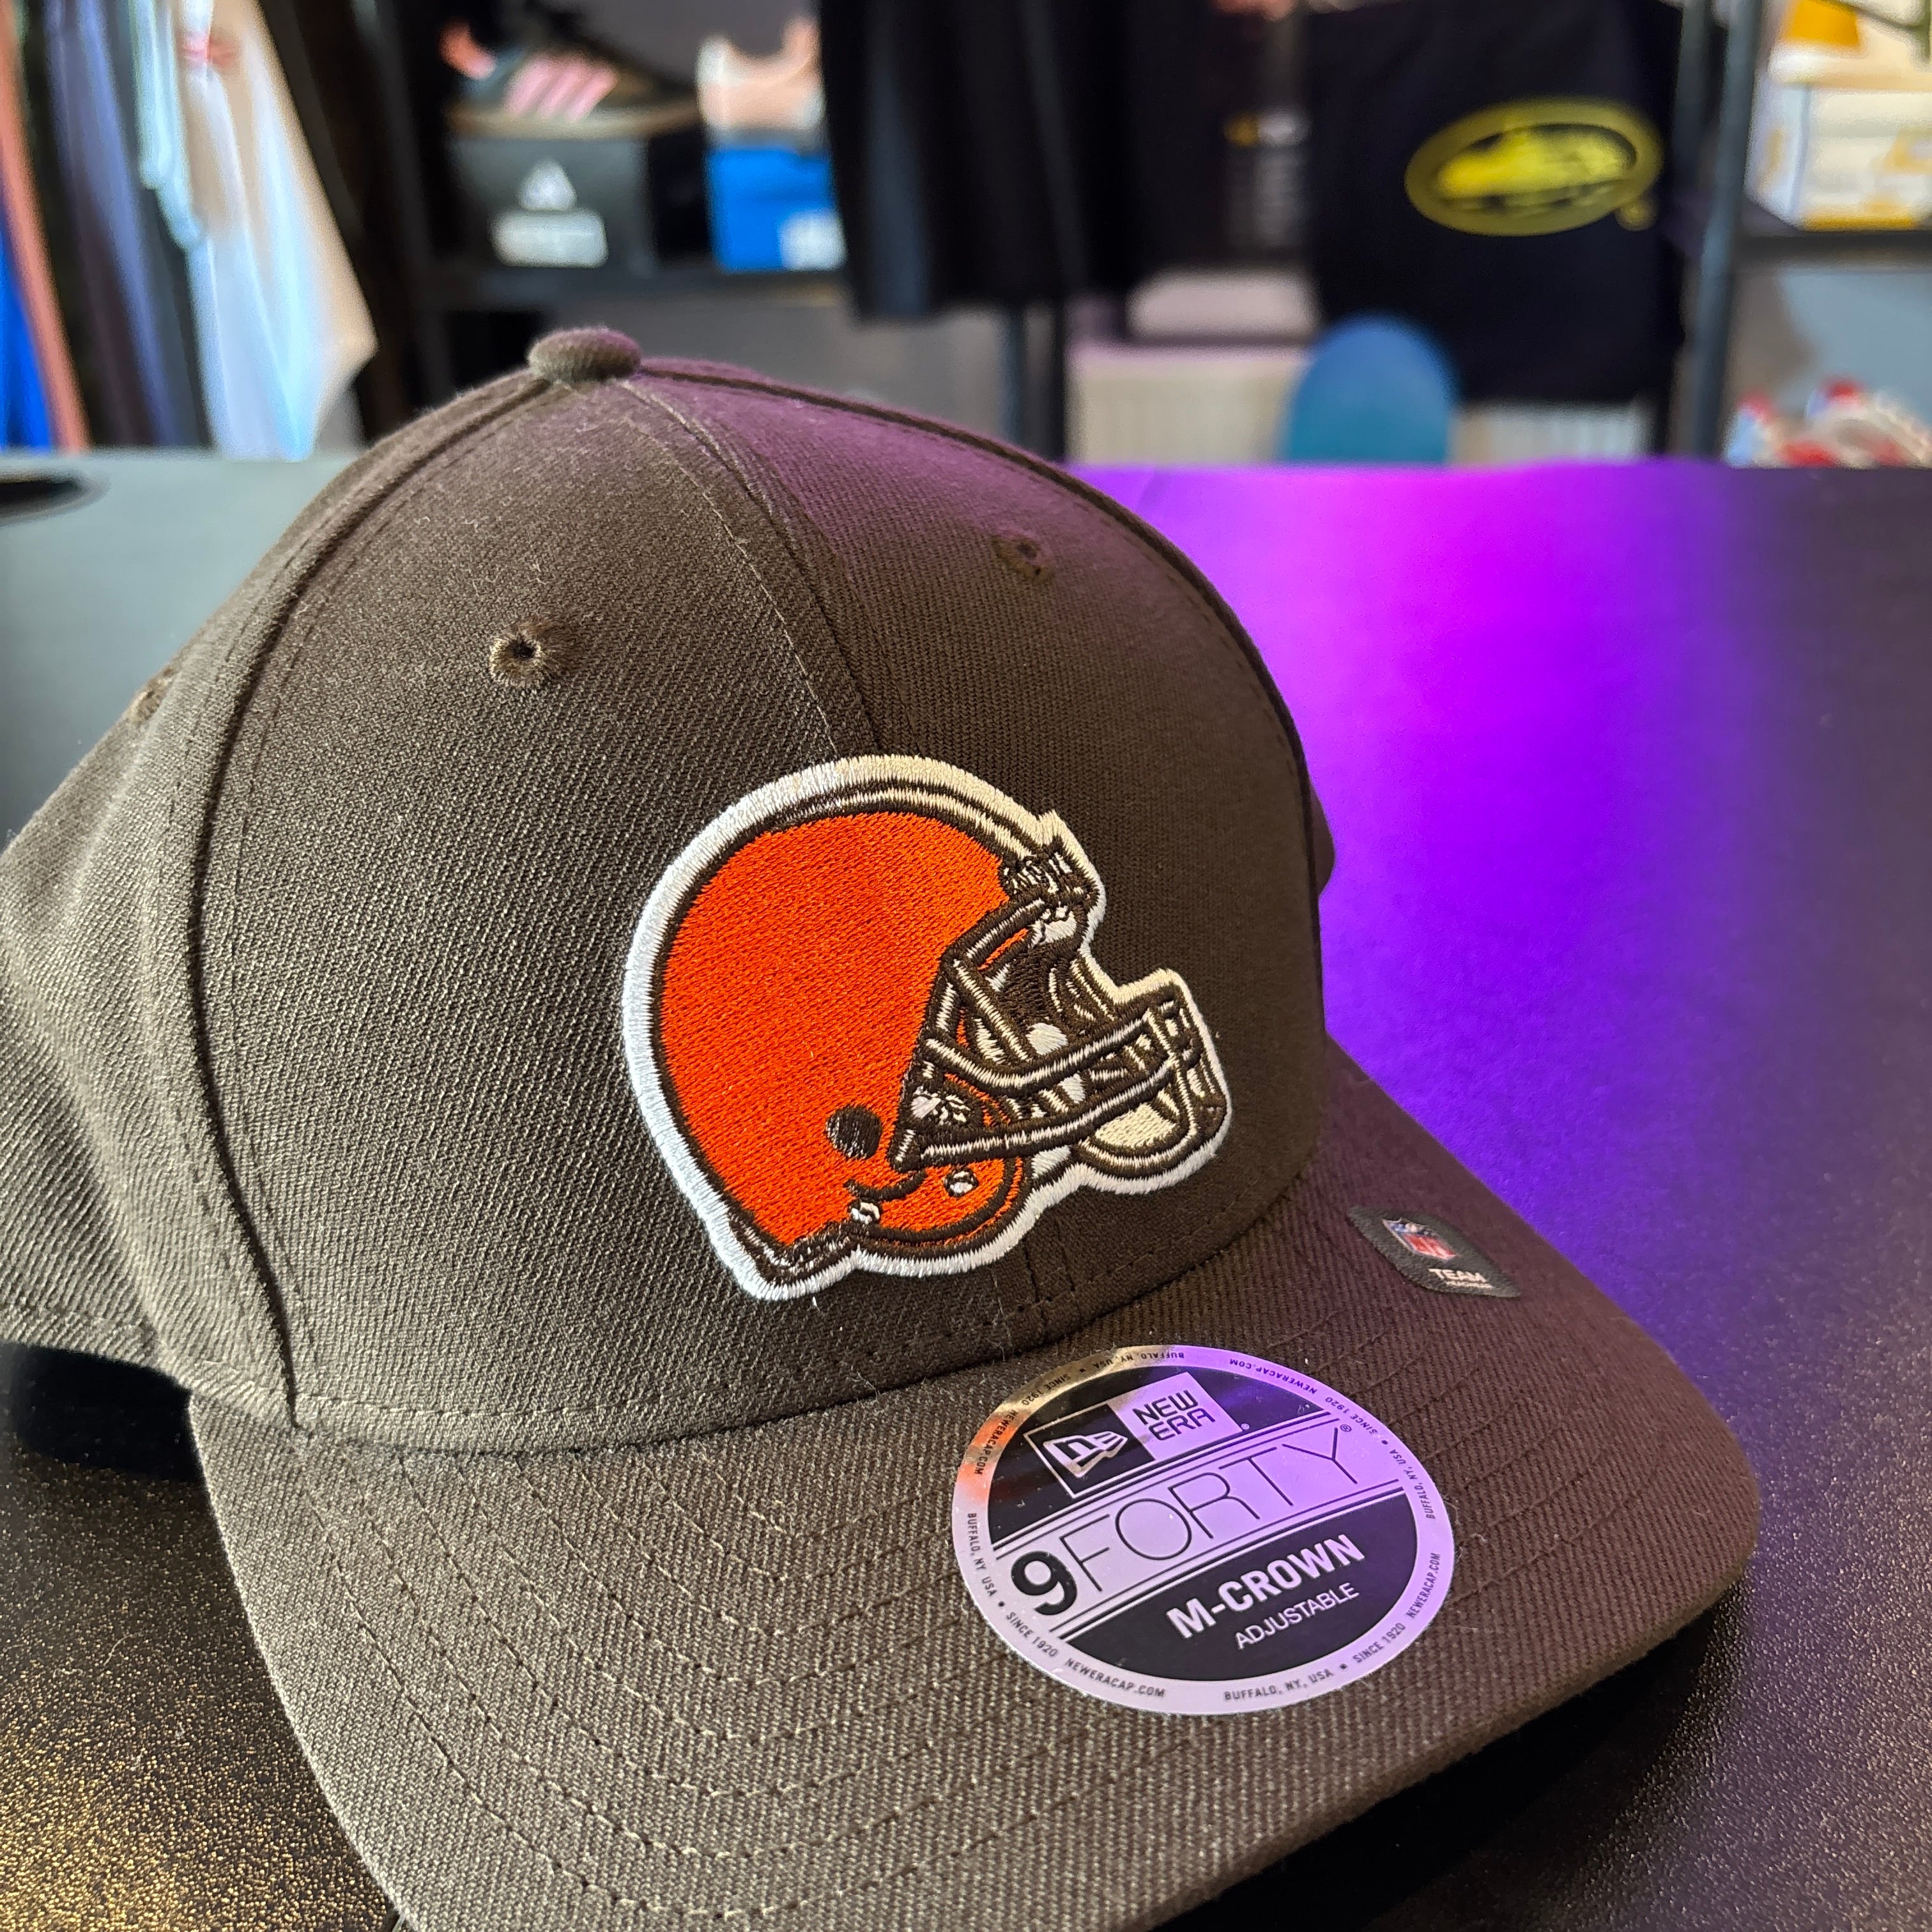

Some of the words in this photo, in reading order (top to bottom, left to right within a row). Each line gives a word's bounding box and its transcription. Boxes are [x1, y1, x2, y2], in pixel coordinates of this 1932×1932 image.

[1093, 1358, 1112, 1369] USA
[1229, 1358, 1319, 1395] NEWERACAP.COM
[1021, 1390, 1043, 1406] 1920
[1046, 1373, 1071, 1391] SINCE
[1132, 1390, 1199, 1425] NEW
[1324, 1396, 1349, 1414] 1920
[1148, 1409, 1216, 1441] ERA
[1349, 1413, 1378, 1436] SINCE
[974, 1409, 1018, 1475] NEWERACAP.COM
[1388, 1448, 1406, 1466] USA
[1166, 1534, 1365, 1639] M-CROWN
[1234, 1581, 1360, 1650] ADJUSTABLE
[1309, 1667, 1335, 1685] USA
[1352, 1641, 1384, 1664] SINCE
[1381, 1621, 1407, 1645] 1920
[1406, 1552, 1442, 1620] NEWERACAP.COM
[981, 1575, 998, 1598] USA
[1006, 1611, 1034, 1639] SINCE
[1032, 1636, 1059, 1659] 1920
[1063, 1657, 1167, 1698] NEWERACAP.COM
